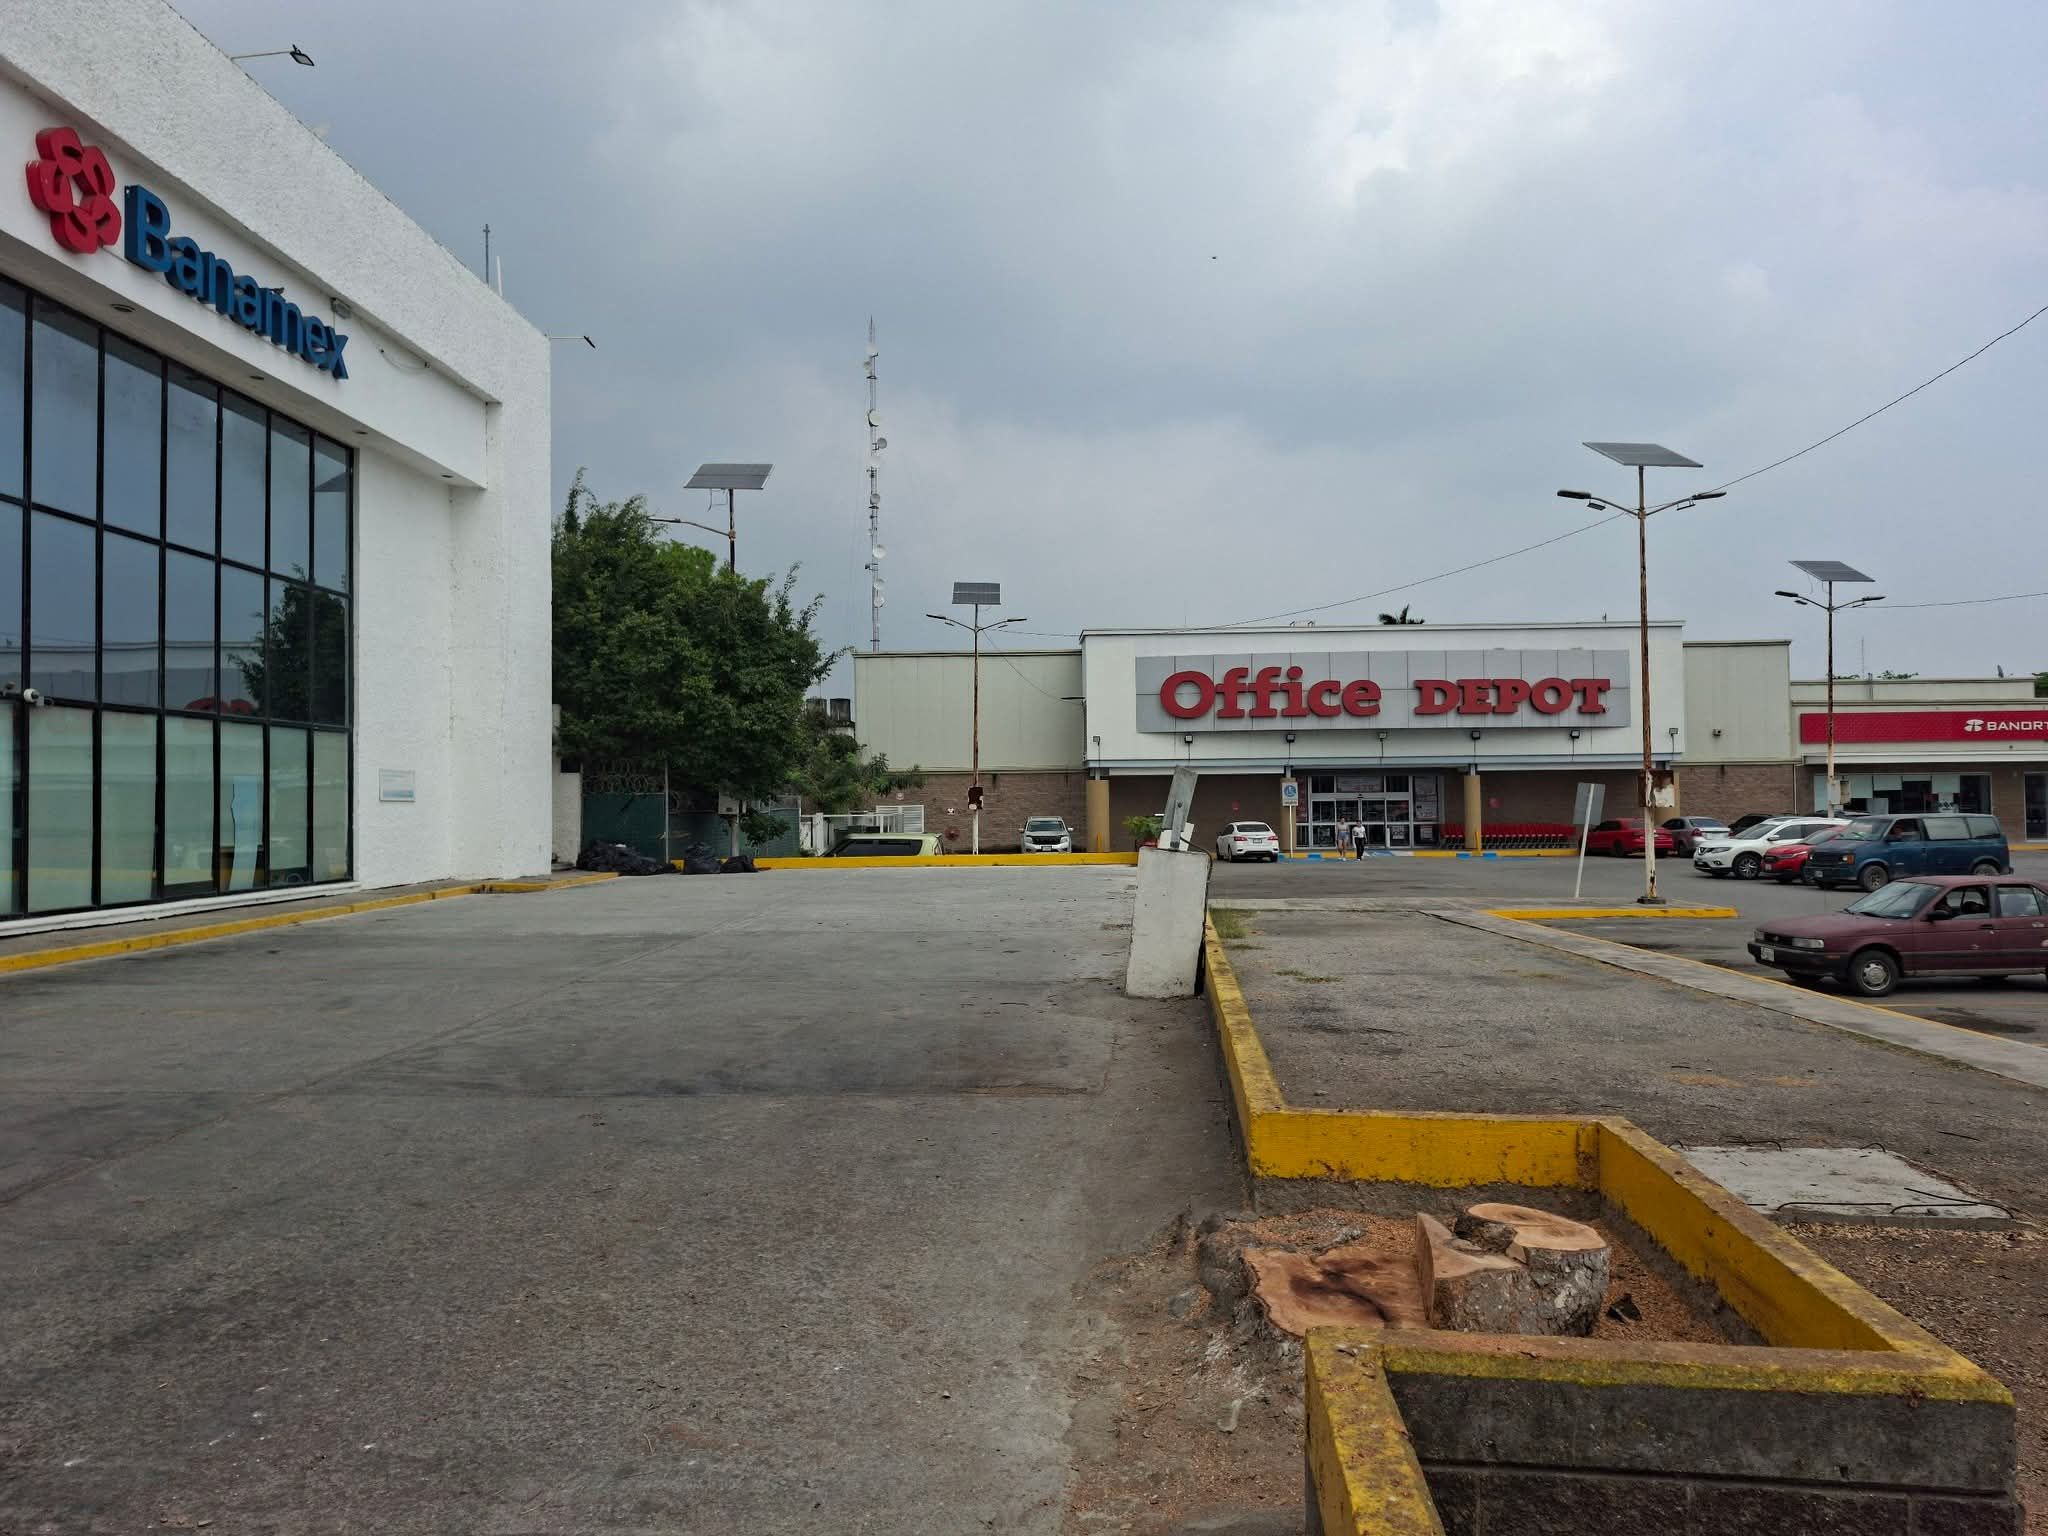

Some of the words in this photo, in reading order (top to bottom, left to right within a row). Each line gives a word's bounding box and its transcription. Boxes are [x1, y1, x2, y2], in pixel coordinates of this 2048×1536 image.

[124, 185, 348, 379] Banamex
[1159, 666, 1382, 719] Office
[1413, 677, 1610, 715] DEPOT
